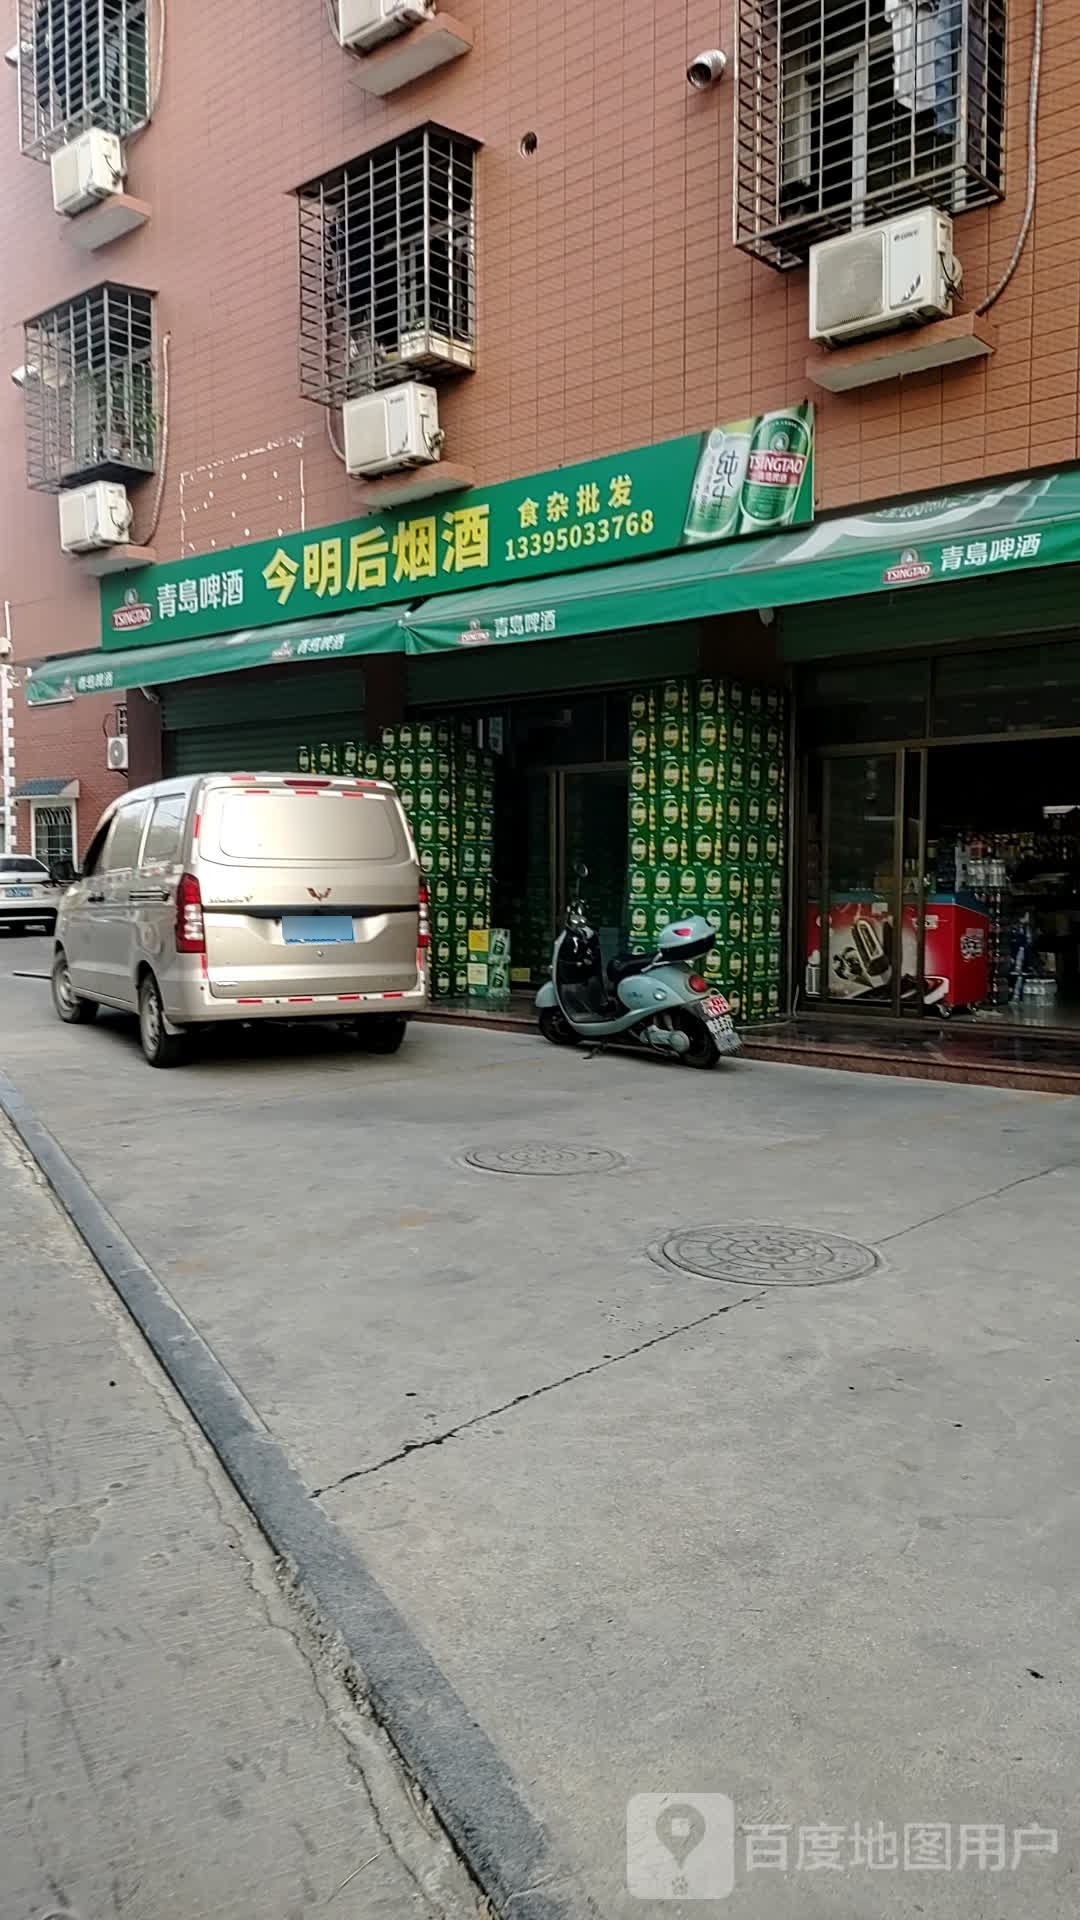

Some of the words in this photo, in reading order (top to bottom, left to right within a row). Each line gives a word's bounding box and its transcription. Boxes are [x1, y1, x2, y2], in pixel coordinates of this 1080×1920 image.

[748, 454, 804, 474] TSINGTAO
[517, 473, 633, 529] 食杂批发
[505, 509, 654, 561] 13395033768
[261, 503, 490, 606] 今明后烟酒
[887, 565, 931, 582] TSINGTAO
[113, 607, 152, 627] TSINGTAO
